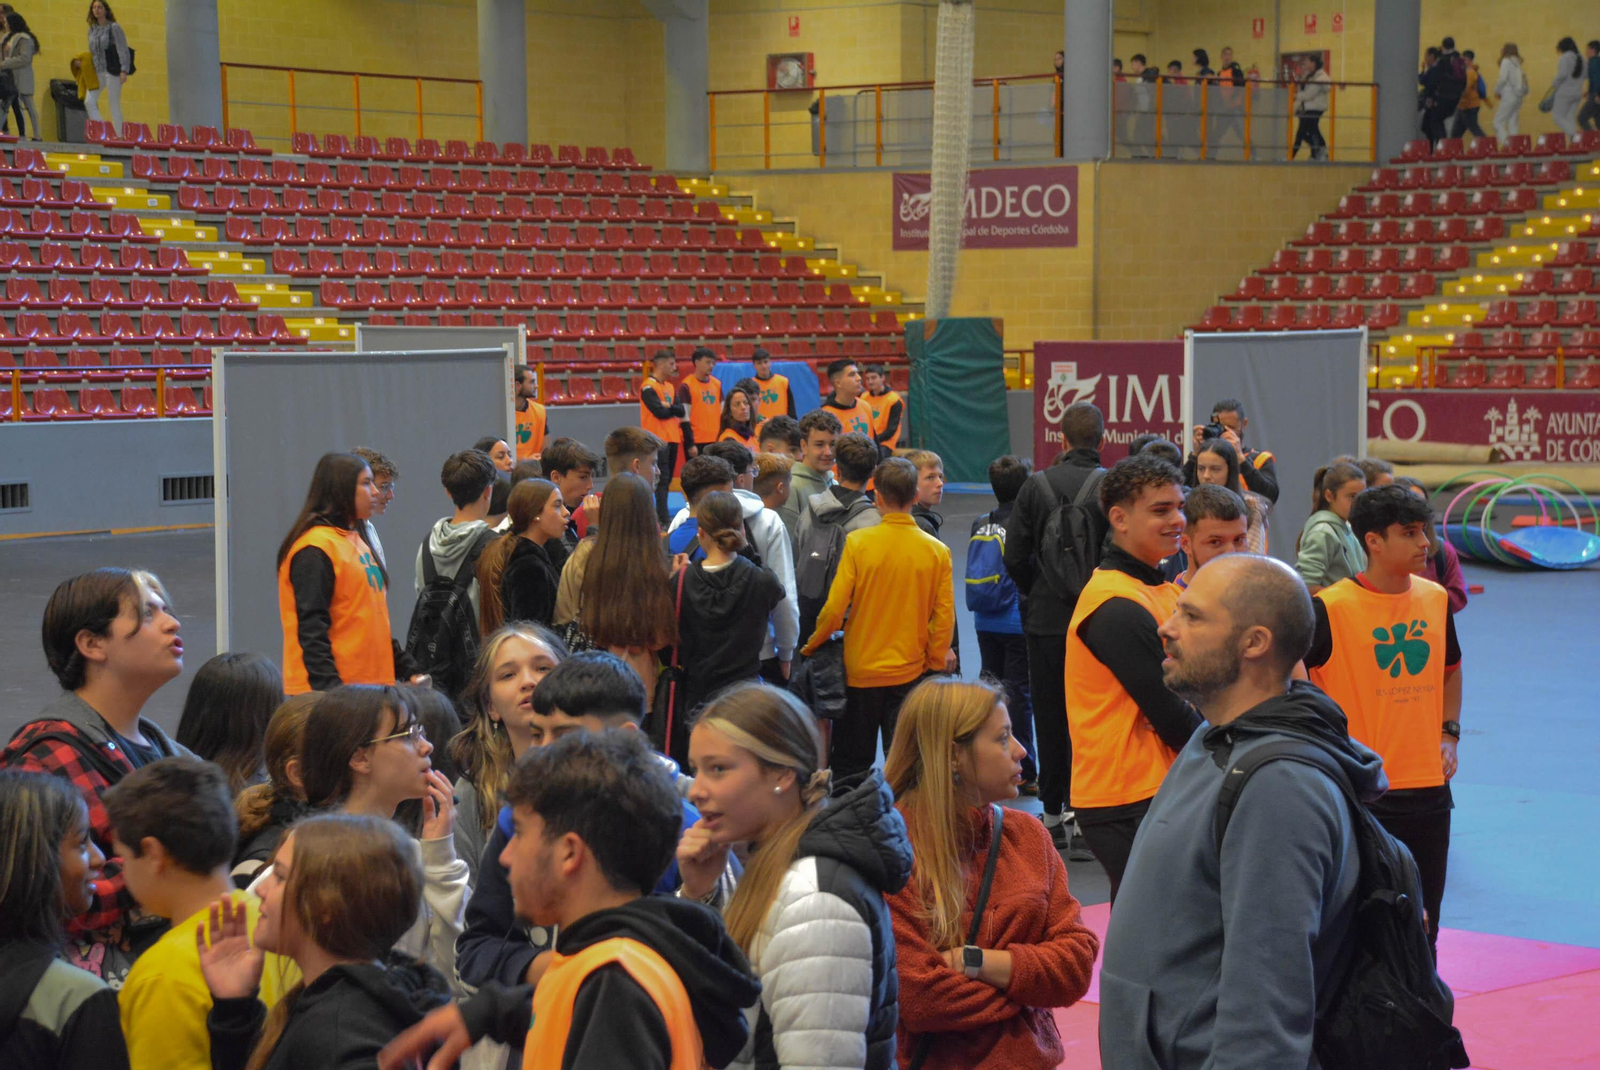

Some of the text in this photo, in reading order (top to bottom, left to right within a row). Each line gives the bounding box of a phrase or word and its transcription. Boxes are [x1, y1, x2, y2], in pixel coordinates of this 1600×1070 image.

[978, 227, 989, 236] de
[991, 226, 1030, 237] Deportes
[1032, 223, 1069, 236] Córdoba
[1107, 374, 1185, 423] IM
[1546, 438, 1566, 461] DE
